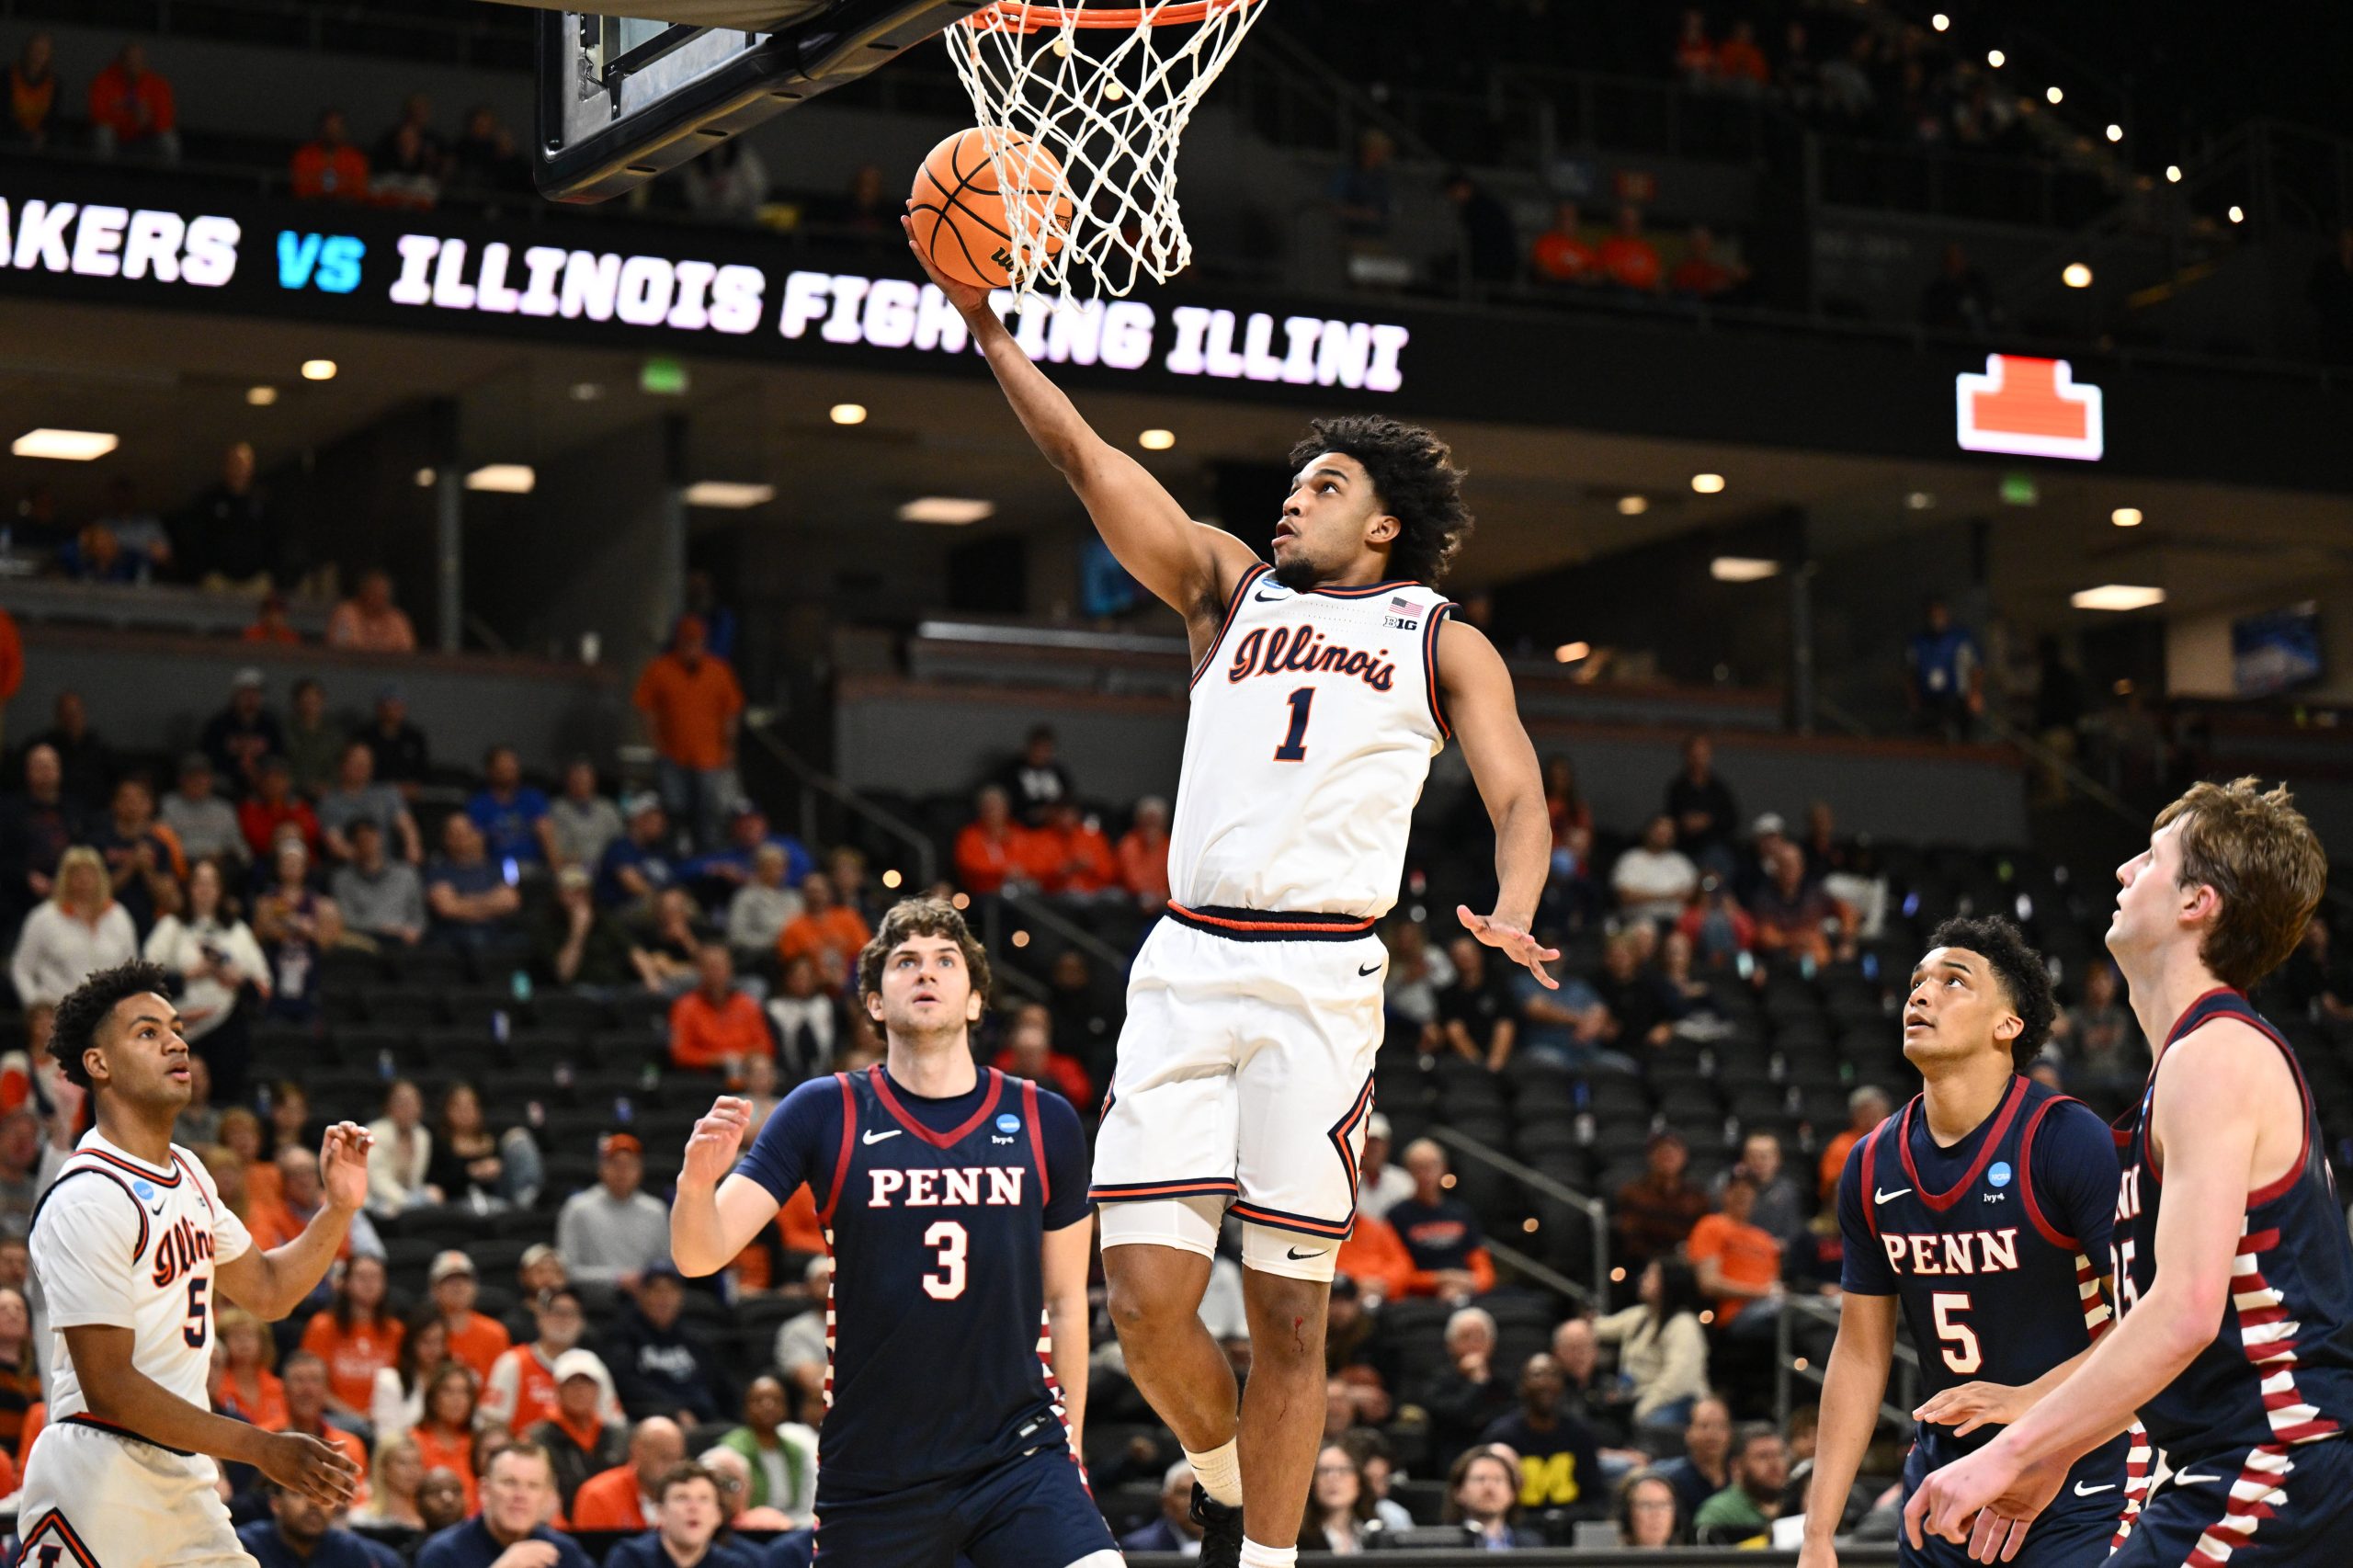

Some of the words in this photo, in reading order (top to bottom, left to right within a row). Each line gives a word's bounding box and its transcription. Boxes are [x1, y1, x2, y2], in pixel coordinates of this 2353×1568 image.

[0, 197, 241, 287] KERS
[277, 230, 366, 293] VS
[390, 234, 766, 334] ILLINOIS
[1165, 306, 1409, 392] ILLINI
[1228, 623, 1396, 693] Illinois
[1273, 687, 1316, 762] 1
[868, 1166, 1026, 1208] PENN
[922, 1219, 968, 1301] 3
[1881, 1226, 2020, 1276] PENN
[184, 1277, 208, 1348] 5
[1932, 1290, 1984, 1375] 5
